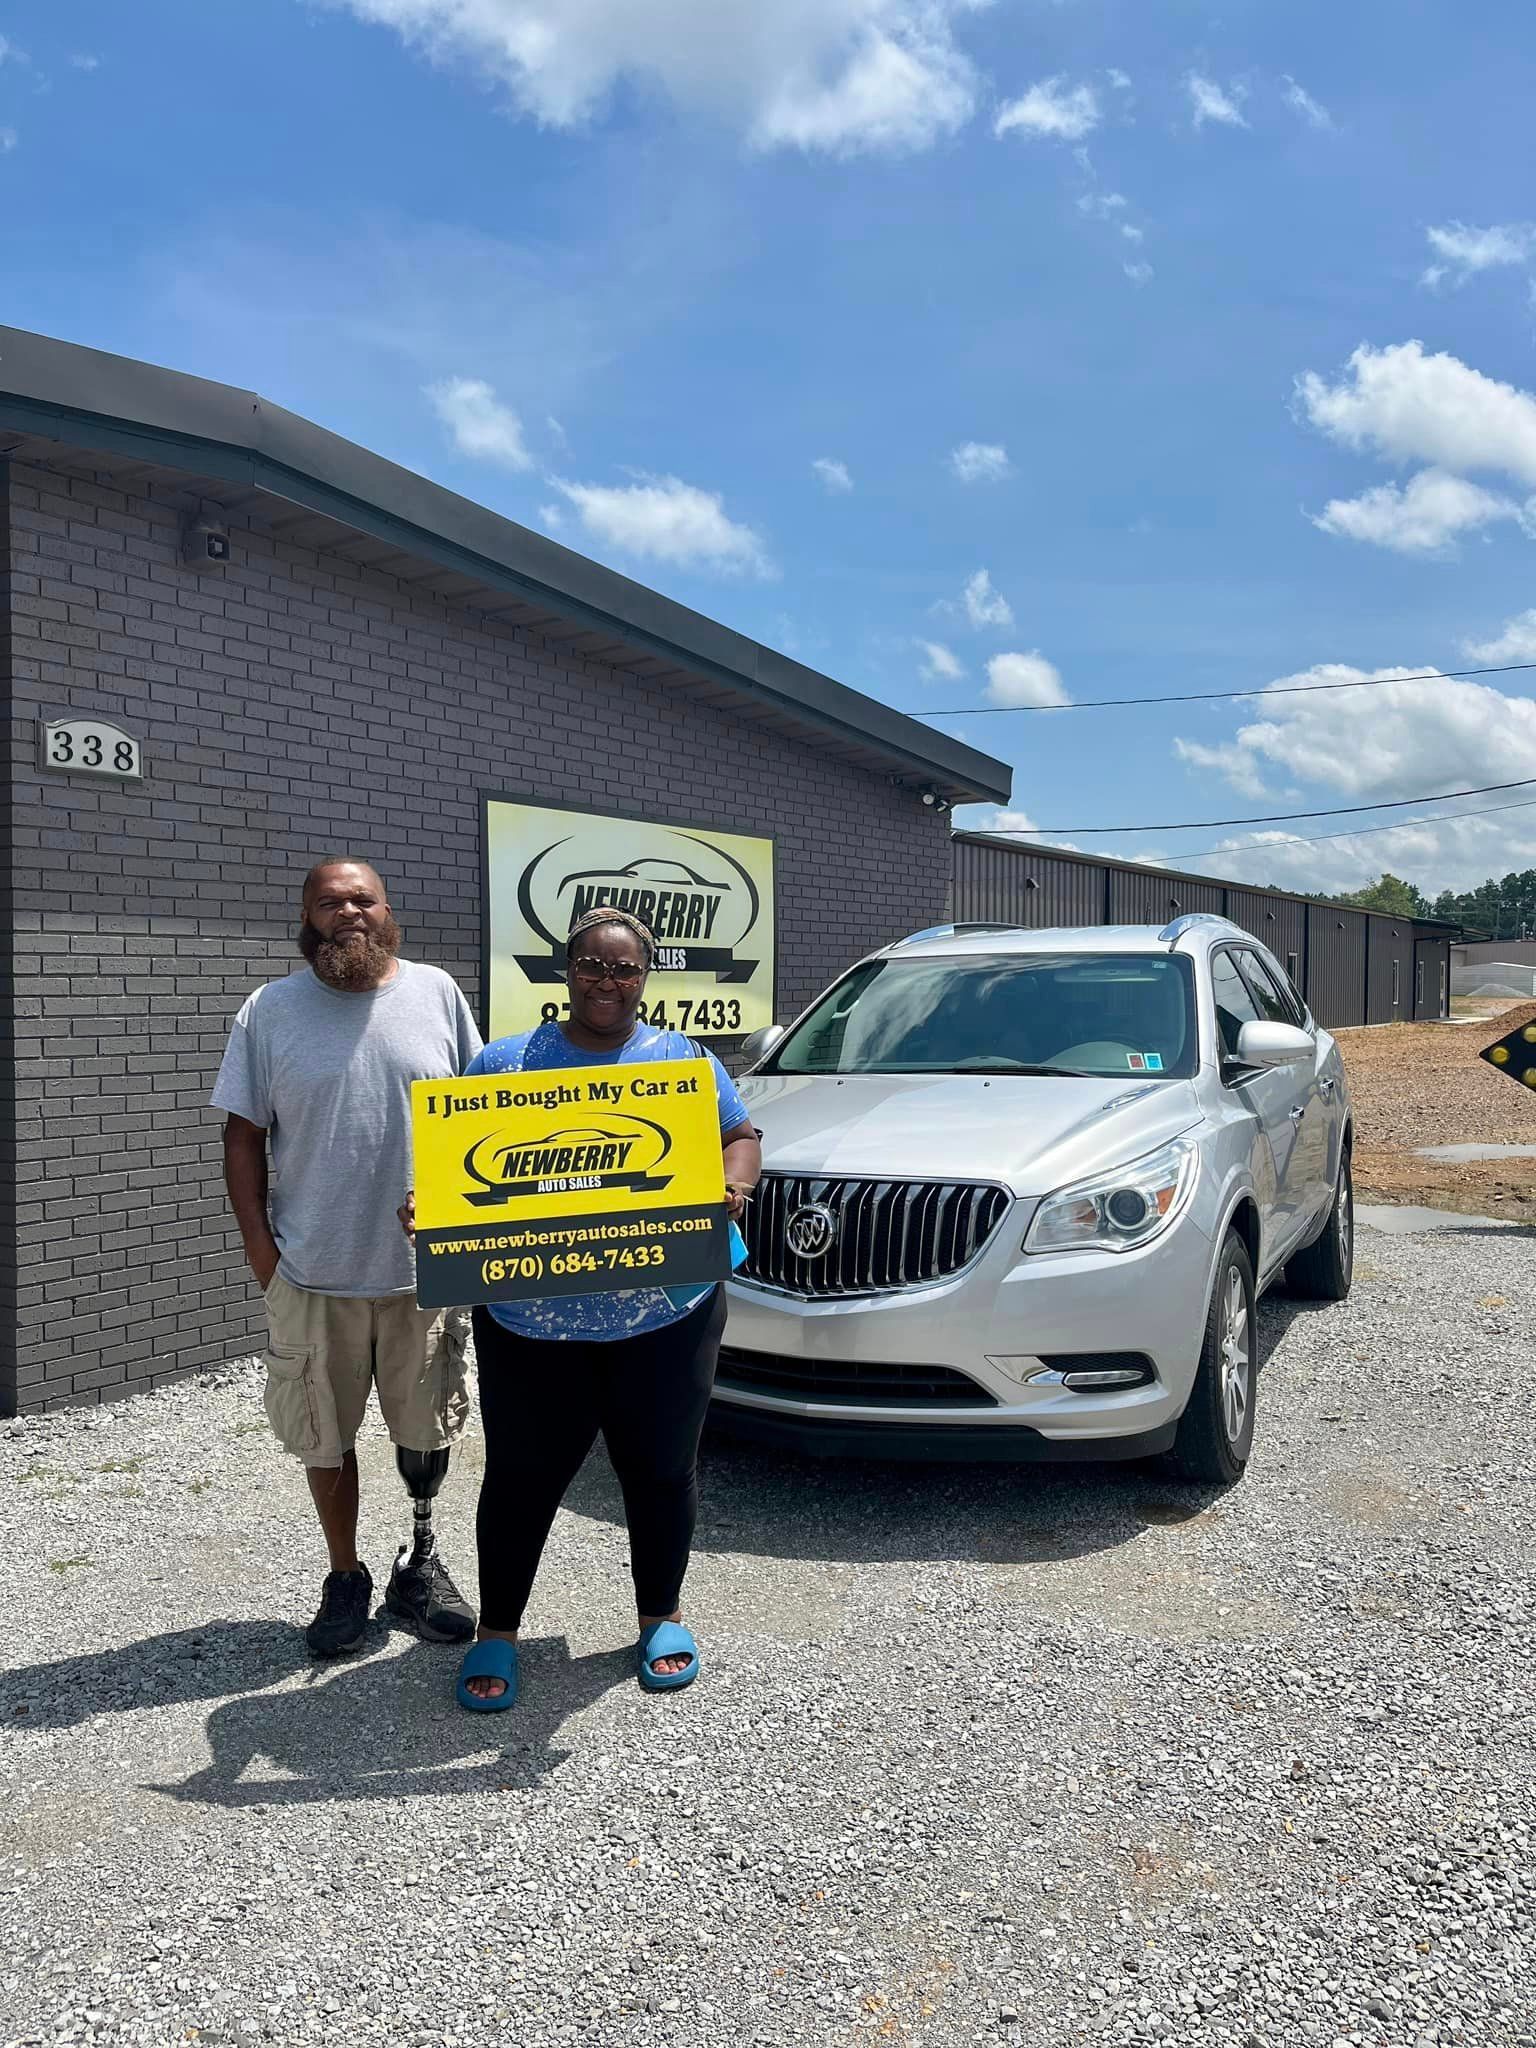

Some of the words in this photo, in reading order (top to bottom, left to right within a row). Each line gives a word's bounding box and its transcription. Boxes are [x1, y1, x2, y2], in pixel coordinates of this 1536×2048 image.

[52, 731, 134, 771] 338
[427, 1096, 437, 1114] I
[443, 1093, 489, 1118] Just
[495, 1084, 582, 1109] Bought
[587, 1081, 624, 1104] My
[630, 1077, 670, 1096] Car
[676, 1076, 698, 1094] at
[501, 1142, 633, 1178] NEWBERRY
[537, 1178, 567, 1193] AUTO
[568, 1175, 602, 1190] SALES
[429, 1217, 713, 1255] www.newberryautosales.com
[481, 1254, 544, 1284] (870)
[550, 1245, 665, 1273] 684-7433
